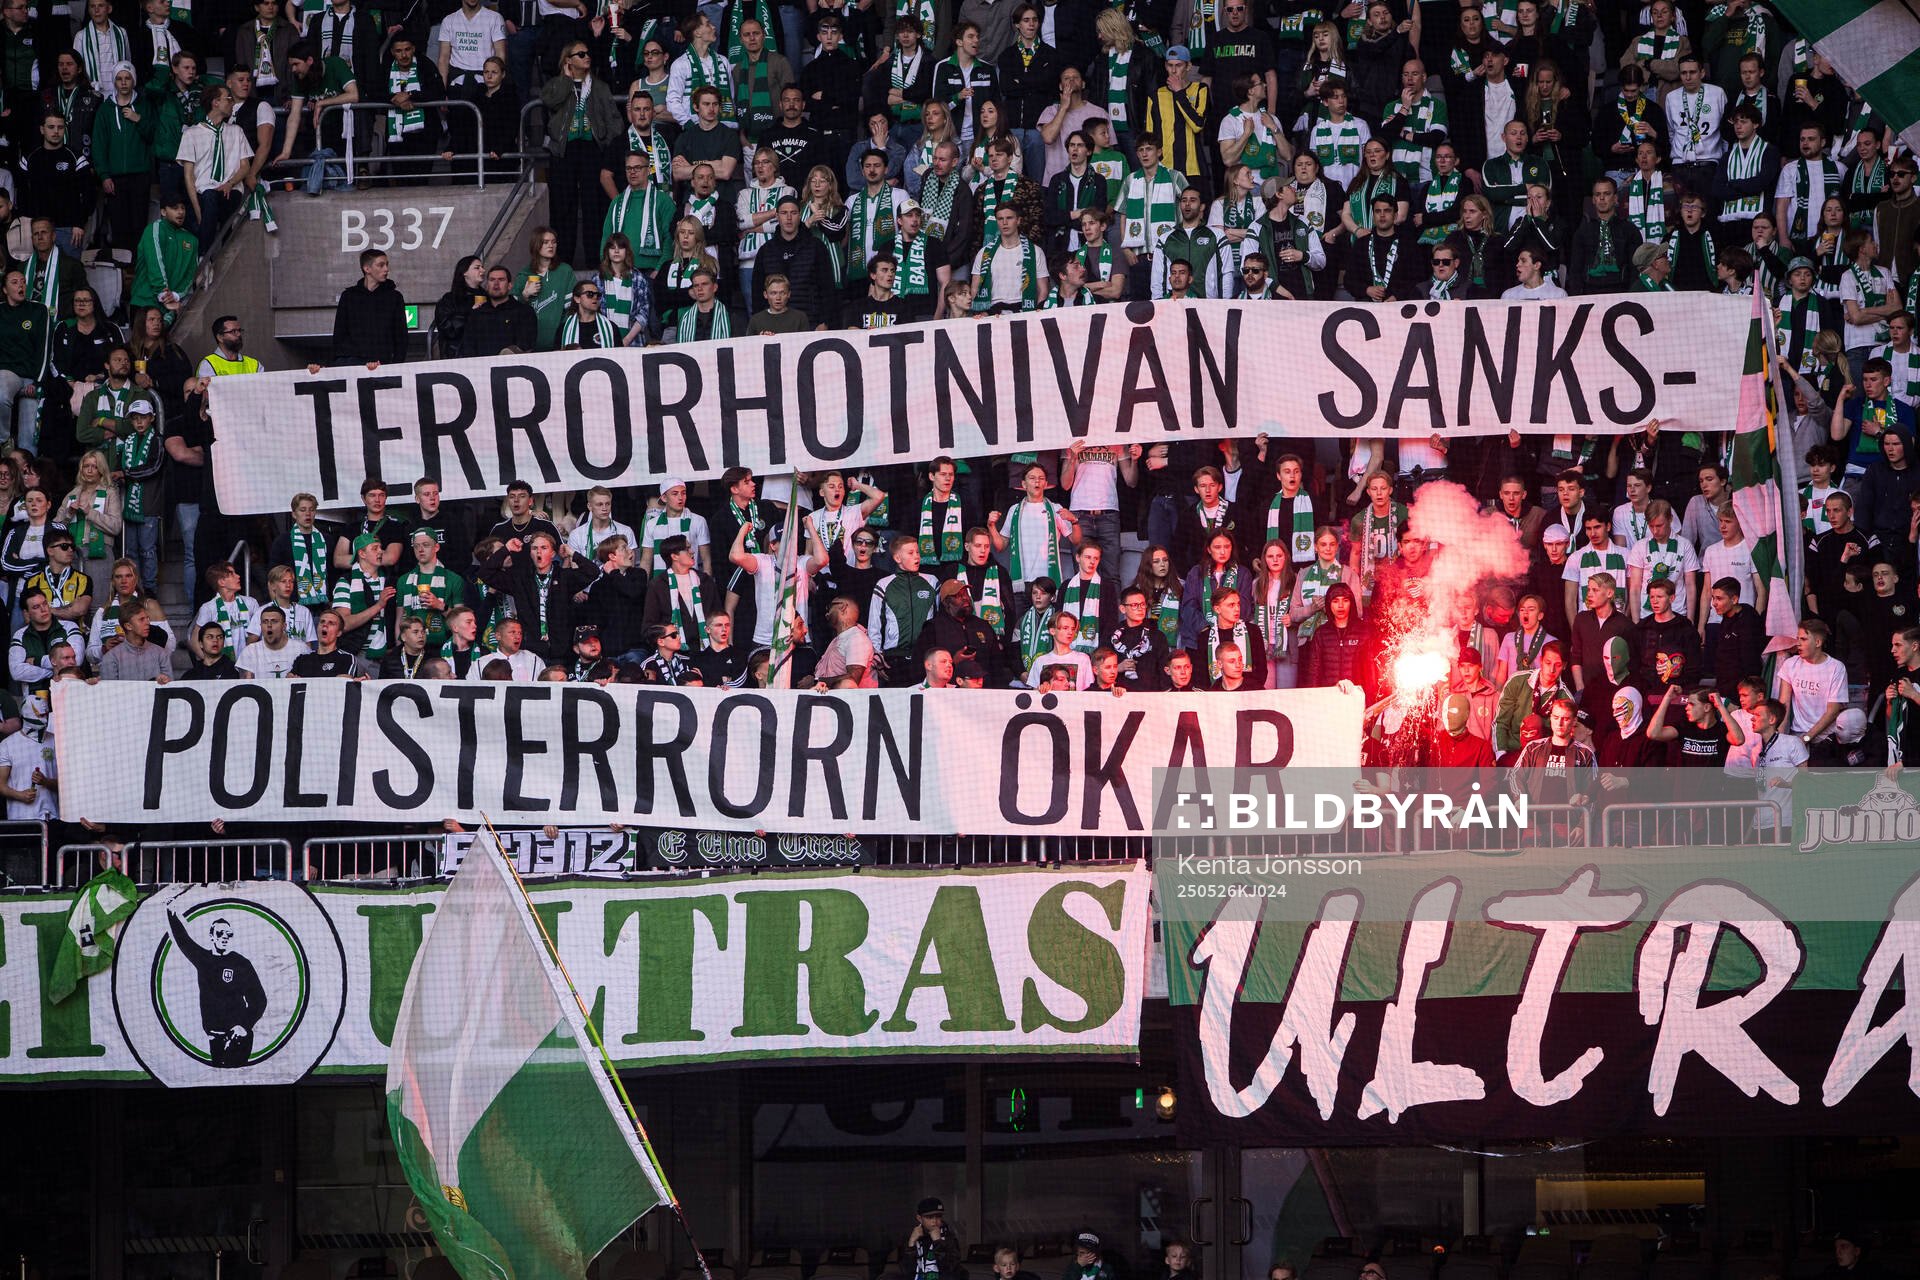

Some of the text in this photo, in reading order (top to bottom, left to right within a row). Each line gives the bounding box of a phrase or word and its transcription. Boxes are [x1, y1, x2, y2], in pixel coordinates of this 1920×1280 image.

[1213, 44, 1256, 59] AJENCIAGA
[341, 206, 455, 254] B337
[294, 300, 1697, 501] TERRORHOTNIVÅN SÄNKS-
[143, 680, 1296, 832] POLISTERRORN ÖKAR
